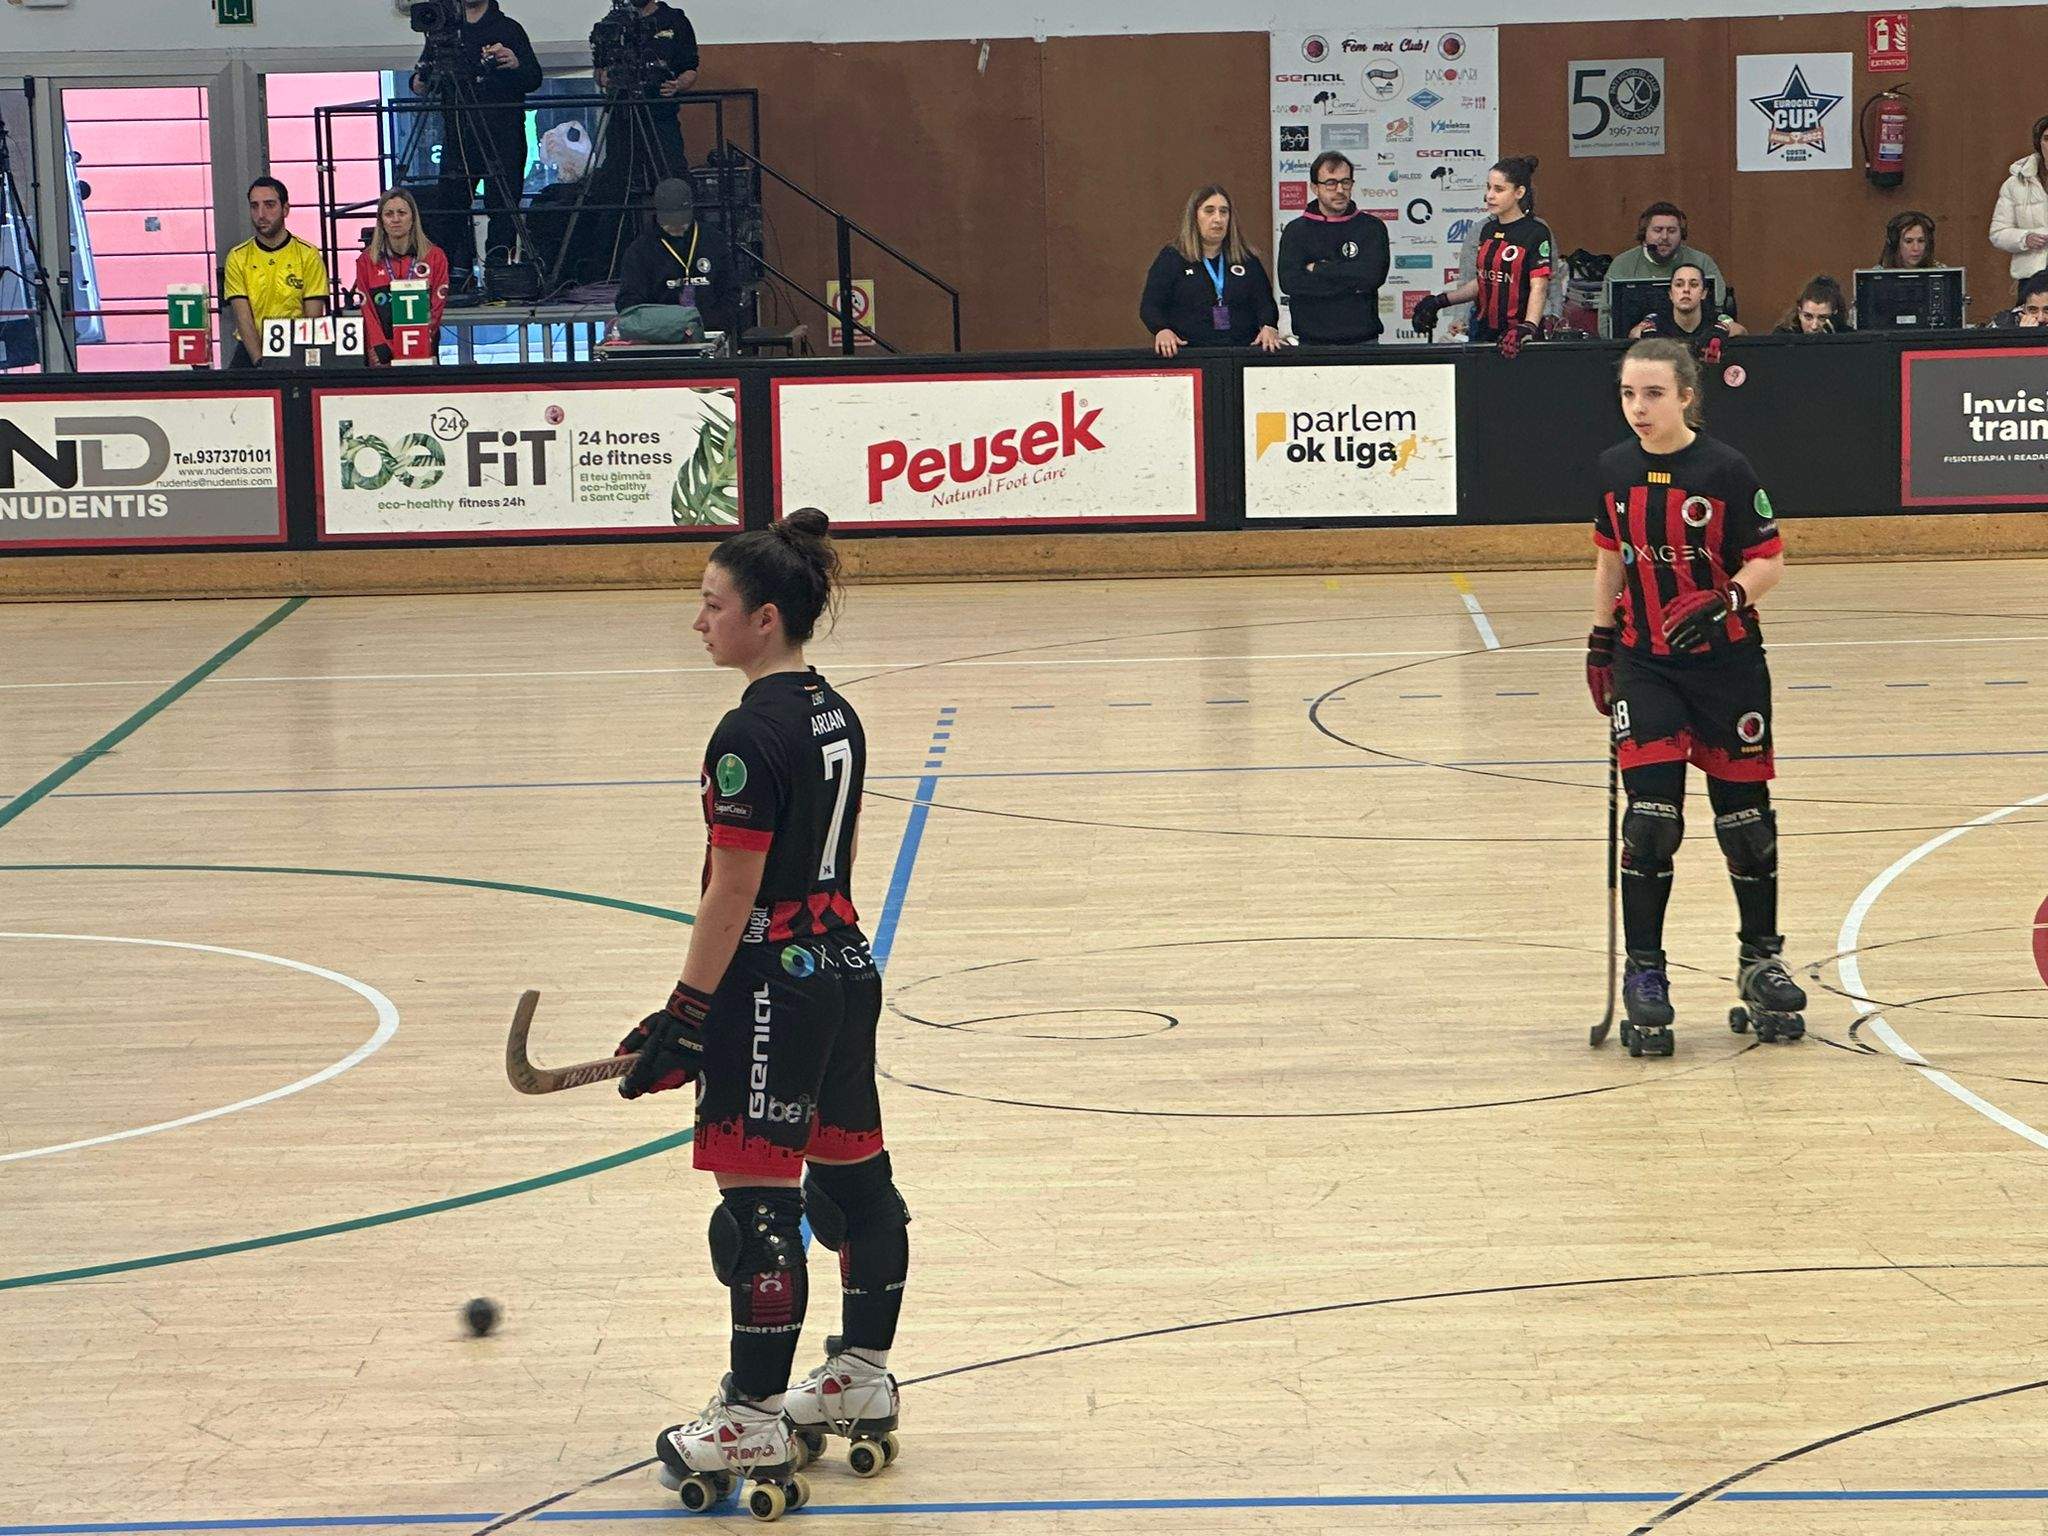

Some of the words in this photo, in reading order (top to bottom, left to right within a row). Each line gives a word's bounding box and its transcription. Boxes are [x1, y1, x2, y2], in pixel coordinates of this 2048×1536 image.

[1773, 99, 1820, 109] EUROCKEY
[1609, 125, 1660, 138] 1967-2017
[1774, 109, 1819, 130] CUP
[175, 299, 196, 325] T
[399, 294, 420, 320] T
[177, 335, 196, 360] F
[269, 324, 285, 353] 8
[299, 321, 307, 341] 1
[320, 320, 329, 341] 1
[402, 329, 420, 355] F
[1963, 389, 2048, 415] Invis
[1293, 404, 1417, 440] parlem
[578, 431, 601, 445] 24
[605, 430, 661, 445] hores
[867, 390, 1106, 505] Peusek
[173, 449, 272, 465] Tel.937370101
[338, 419, 446, 491] be
[579, 451, 603, 466] de
[606, 449, 673, 466] fitness
[1286, 437, 1327, 463] ok
[1335, 436, 1398, 469] liga
[1943, 454, 2006, 463] FISIOTERAPIA
[178, 466, 273, 476] www.nudentis.com
[590, 473, 608, 481] teu
[580, 482, 647, 493] eco-healthy
[589, 492, 614, 502] Sant
[616, 491, 651, 504] Cugat
[931, 479, 993, 509] Natural
[995, 472, 1028, 493] Foot
[1032, 466, 1067, 484] Care
[0, 494, 169, 520] NUDENTIS
[377, 499, 454, 512] eco-healthy
[459, 497, 500, 508] fitness
[502, 496, 526, 508] 24h
[810, 708, 847, 737] ARIAN
[818, 738, 853, 881] 7
